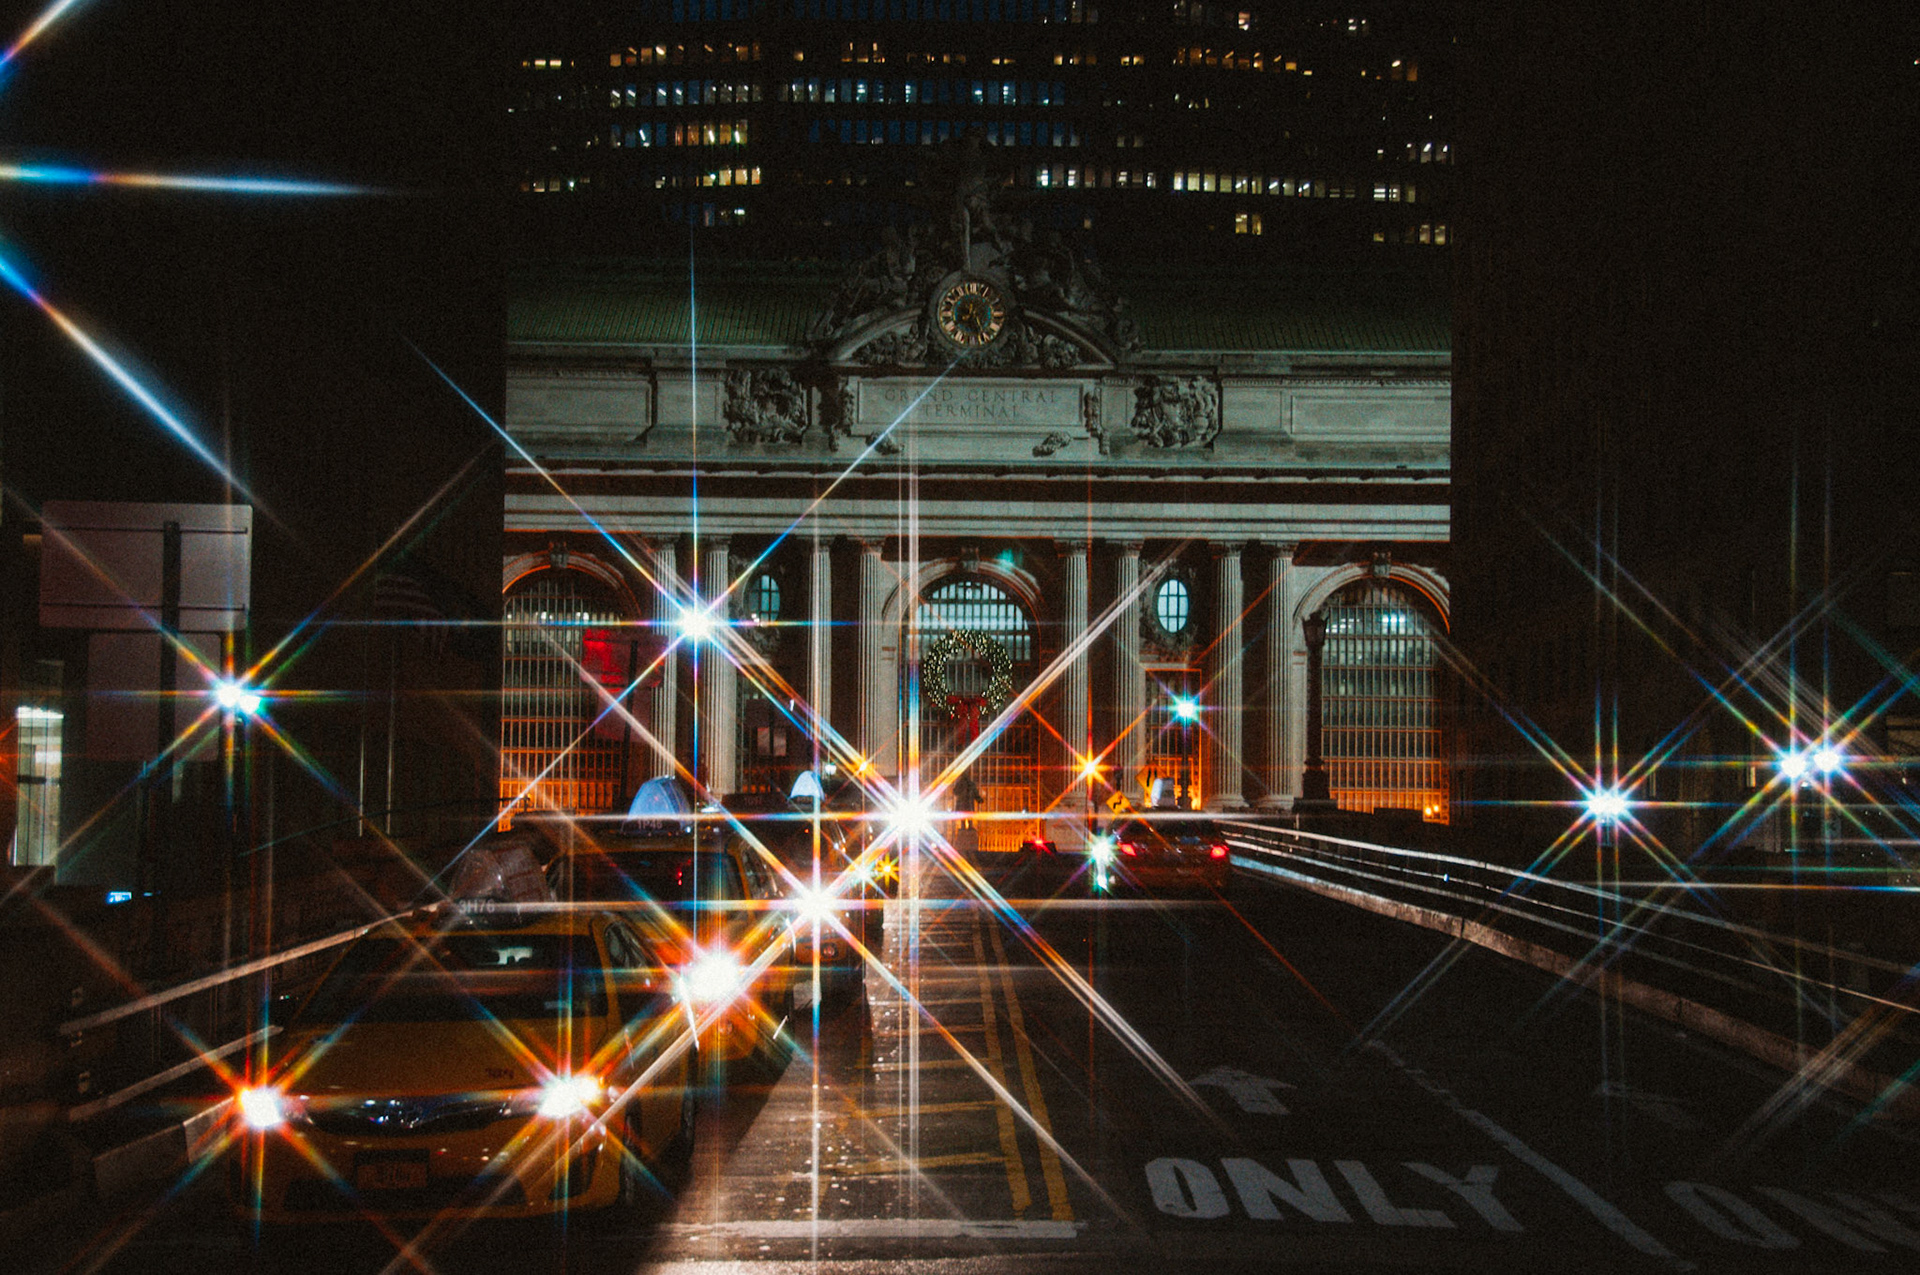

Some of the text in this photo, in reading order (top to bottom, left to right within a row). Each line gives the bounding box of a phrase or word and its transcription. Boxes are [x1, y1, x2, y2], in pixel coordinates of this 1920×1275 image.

[884, 388, 1057, 403] GRAND CENTRAL
[922, 403, 1020, 418] TERMINAL
[1144, 1157, 1525, 1232] ONLY
